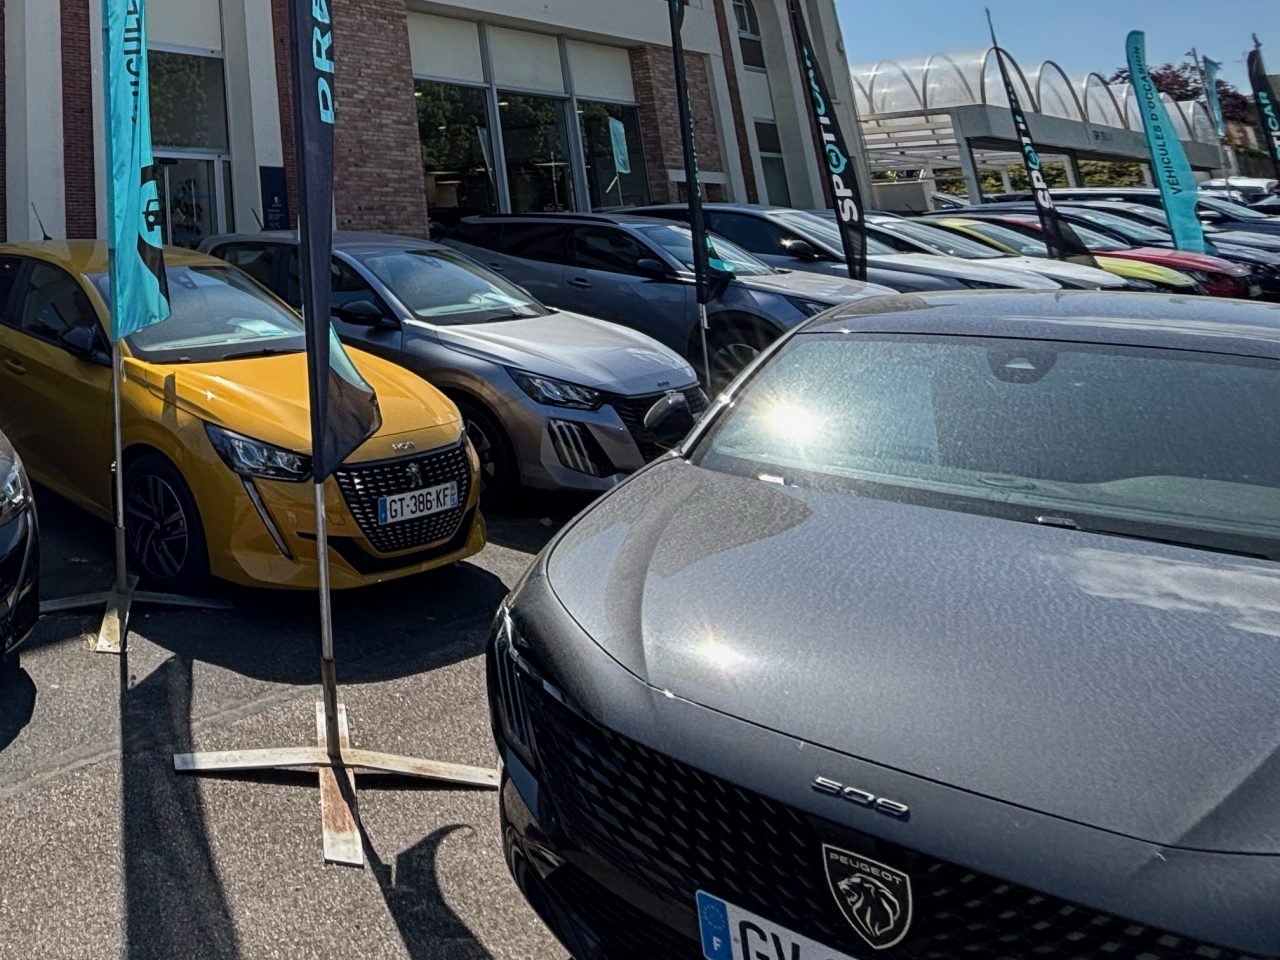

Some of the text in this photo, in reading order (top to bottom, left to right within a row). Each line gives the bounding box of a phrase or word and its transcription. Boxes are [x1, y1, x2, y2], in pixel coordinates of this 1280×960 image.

[389, 486, 450, 519] GT-386-KF
[829, 851, 903, 886] PEUGEOT
[712, 936, 722, 952] F
